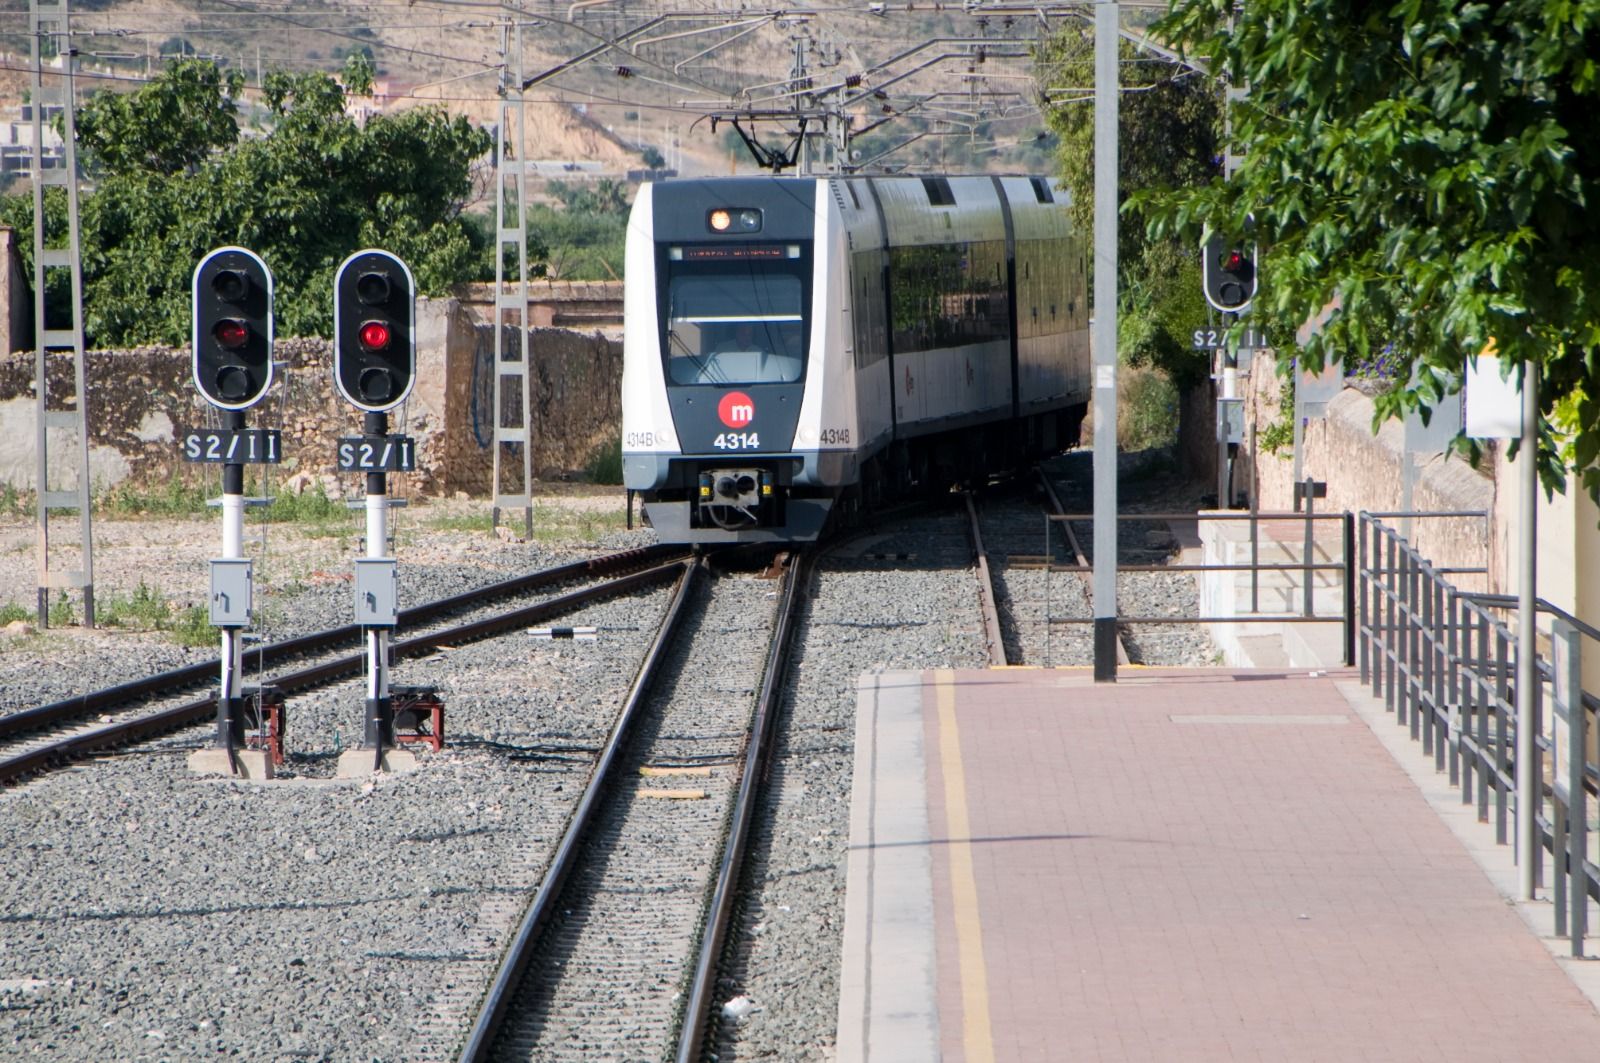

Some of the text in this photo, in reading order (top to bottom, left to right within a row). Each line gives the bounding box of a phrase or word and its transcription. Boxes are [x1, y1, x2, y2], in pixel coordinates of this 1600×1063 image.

[626, 432, 653, 447] 4314B
[713, 433, 760, 450] 4314
[820, 429, 850, 445] 4314B
[186, 434, 275, 459] S2/II
[339, 443, 409, 468] S2/I
